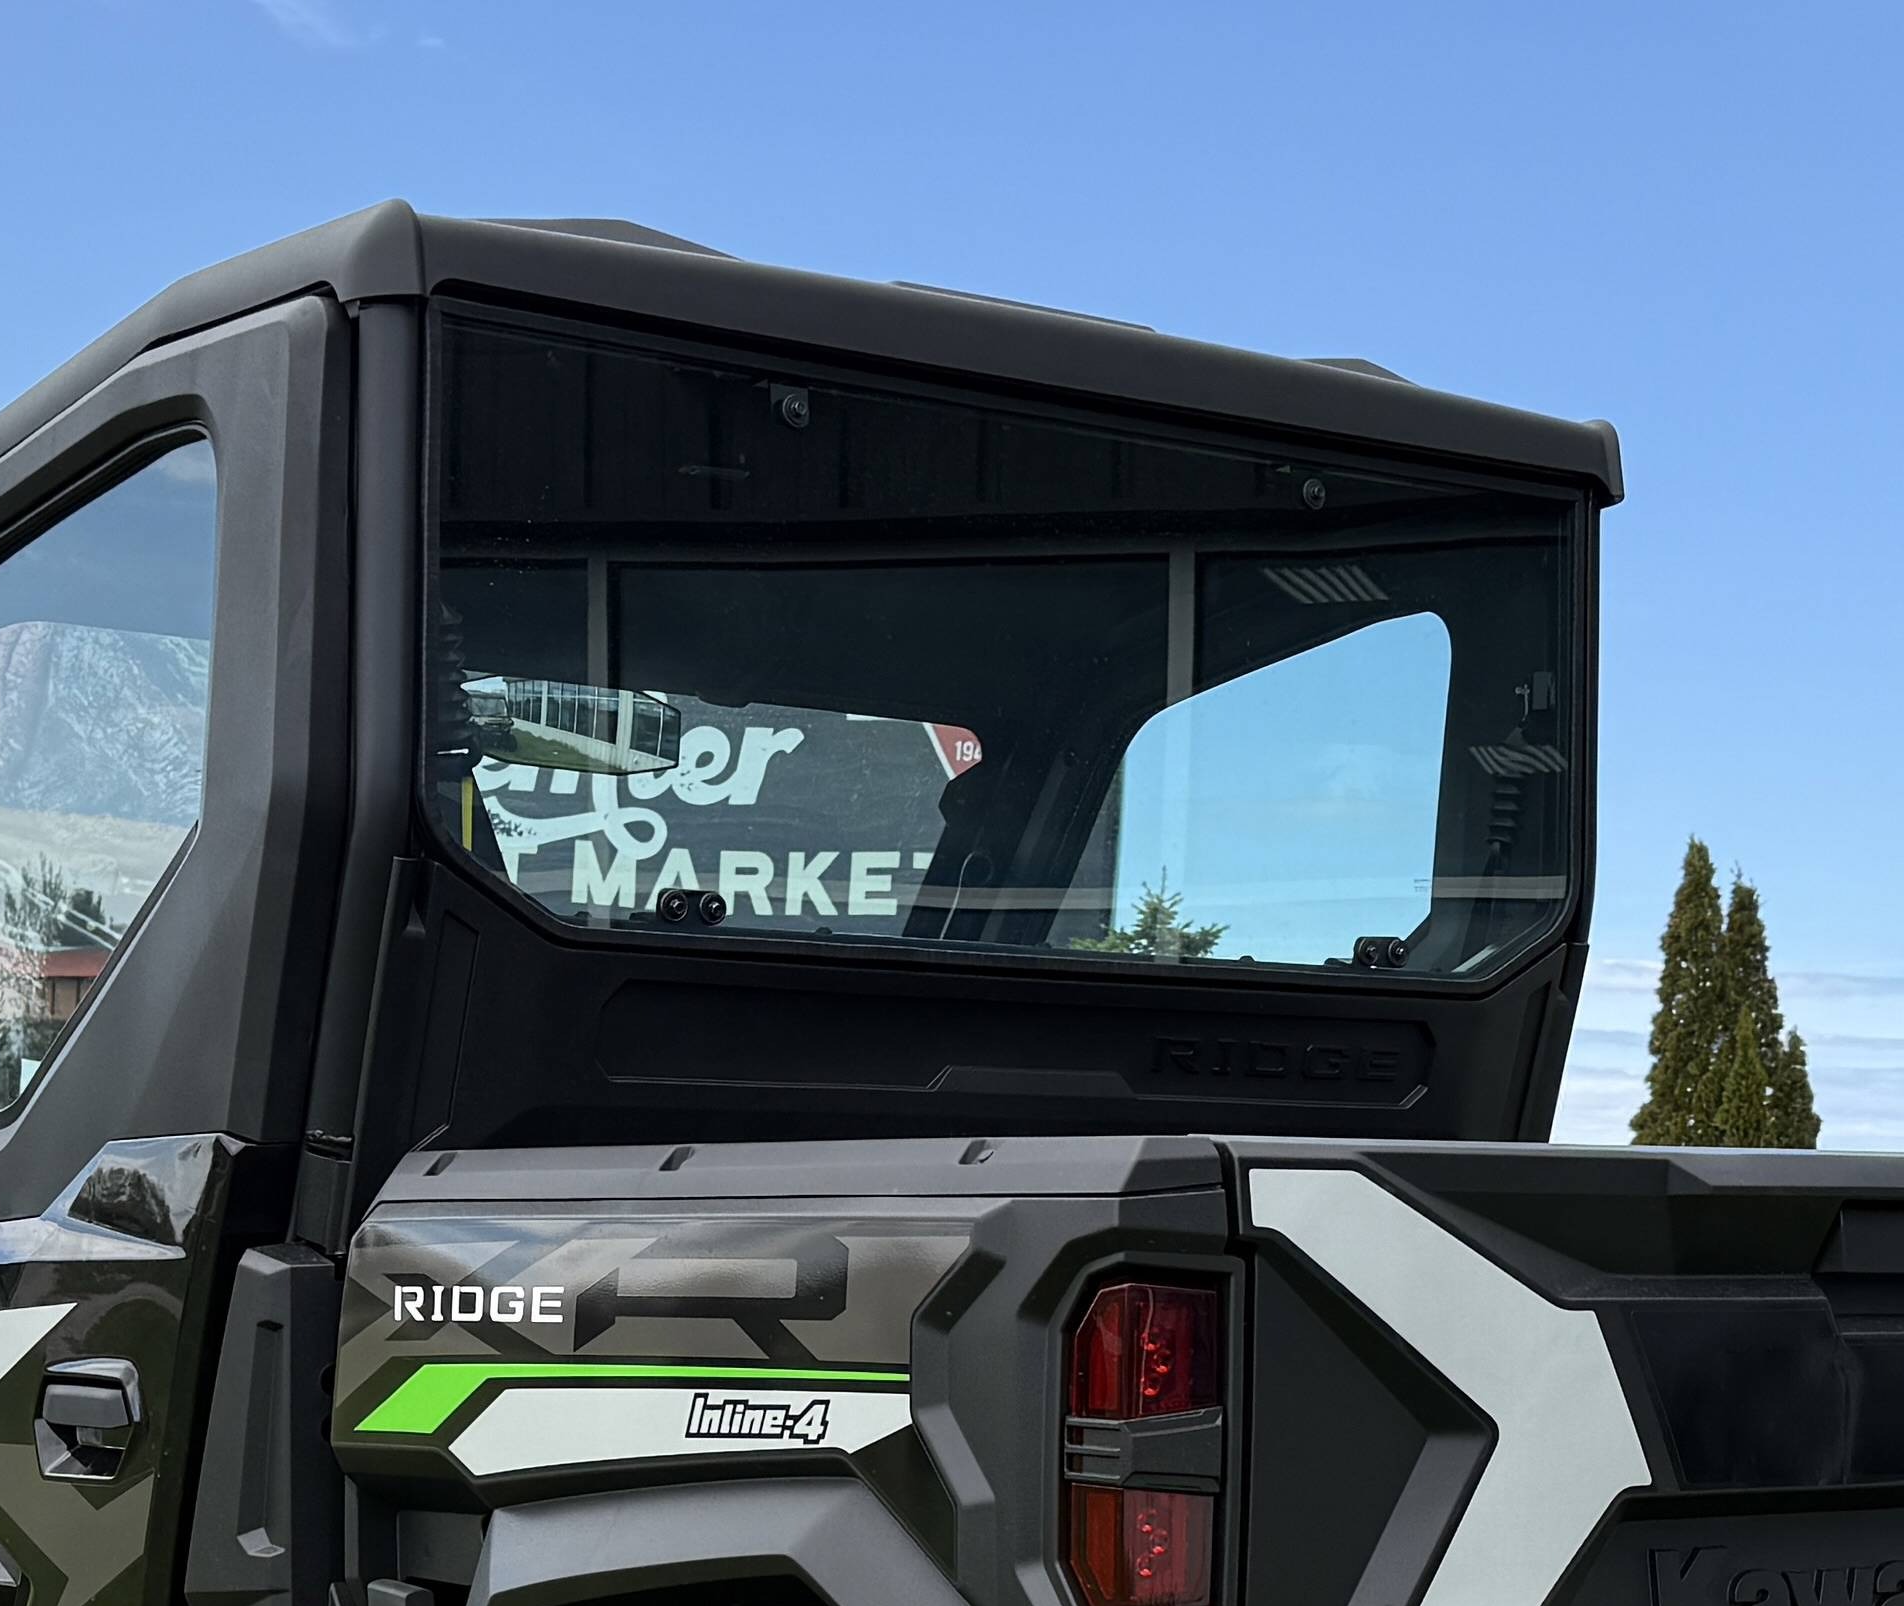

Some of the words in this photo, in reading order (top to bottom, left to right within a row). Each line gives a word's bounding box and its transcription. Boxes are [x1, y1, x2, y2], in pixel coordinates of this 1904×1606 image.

[571, 839, 935, 917] MARKE
[1152, 1035, 1402, 1082] RIDGE
[394, 1285, 566, 1324] RIDGE
[685, 1392, 831, 1445] Inline-4
